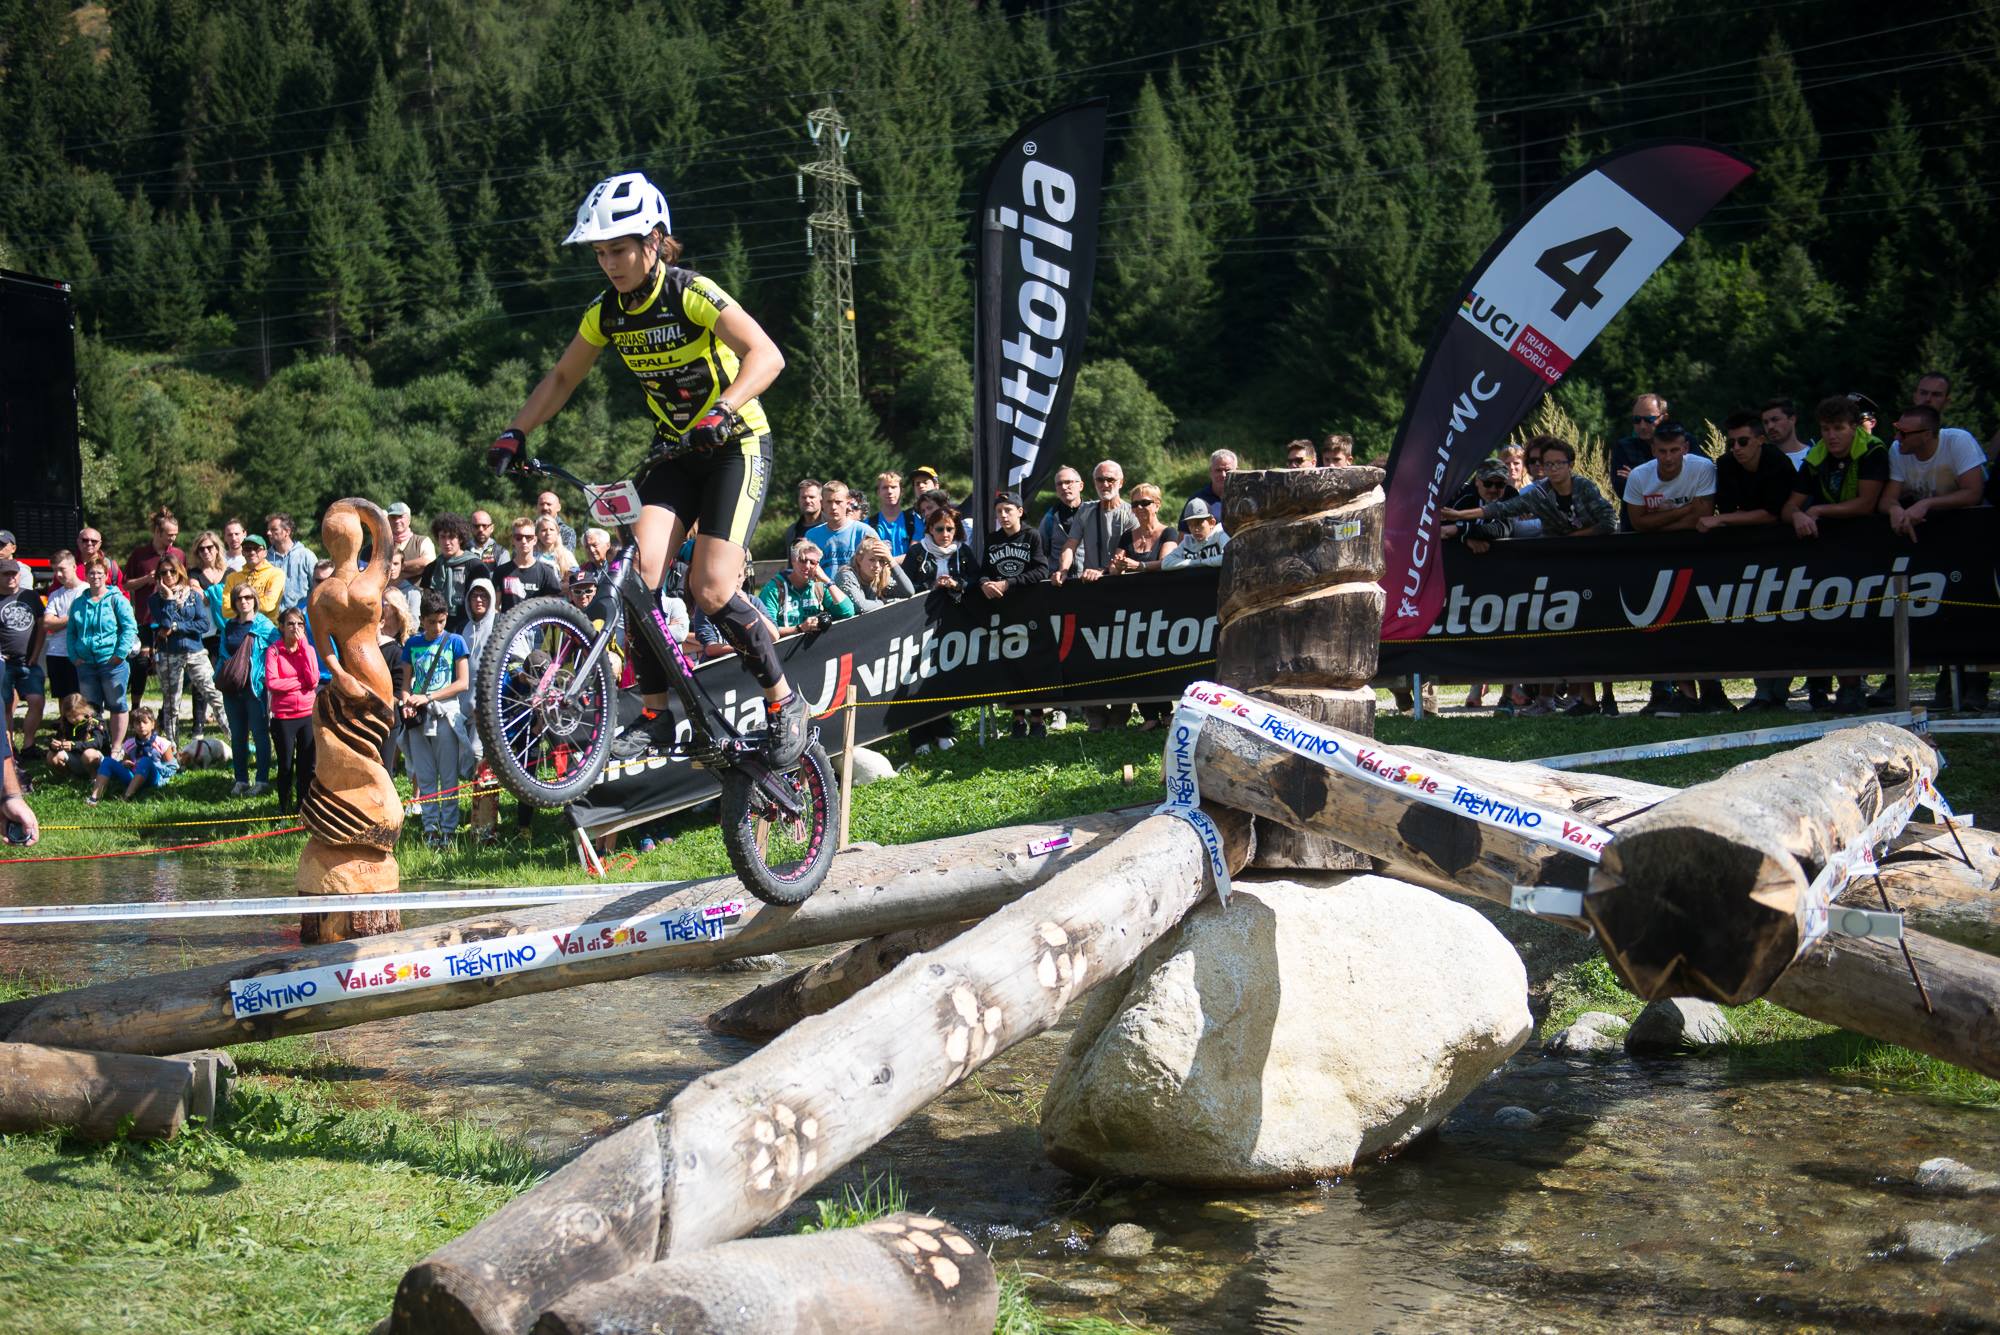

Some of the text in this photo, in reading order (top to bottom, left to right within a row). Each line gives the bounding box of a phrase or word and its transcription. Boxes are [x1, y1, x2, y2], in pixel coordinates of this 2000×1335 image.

[1535, 226, 1633, 322] 4
[996, 160, 1077, 488] vittoria
[1471, 296, 1520, 343] UCI
[1524, 331, 1553, 357] TRIALS
[628, 355, 682, 368] SPALL
[1516, 342, 1547, 369] WORLD
[1696, 556, 1947, 624] vittoria
[857, 612, 1030, 698] vittoria
[1081, 609, 1219, 660] vittor
[1172, 726, 1194, 808] TRENTINO
[1259, 713, 1340, 755] TRENTINO
[1355, 749, 1380, 773] Val
[1379, 766, 1394, 779] di
[1452, 785, 1542, 828] TRENTINO
[1561, 821, 1592, 846] Val
[335, 968, 367, 993] Val
[369, 973, 383, 987] di
[445, 945, 537, 977] TRENTINO
[553, 933, 585, 958] Val
[587, 937, 601, 952] di
